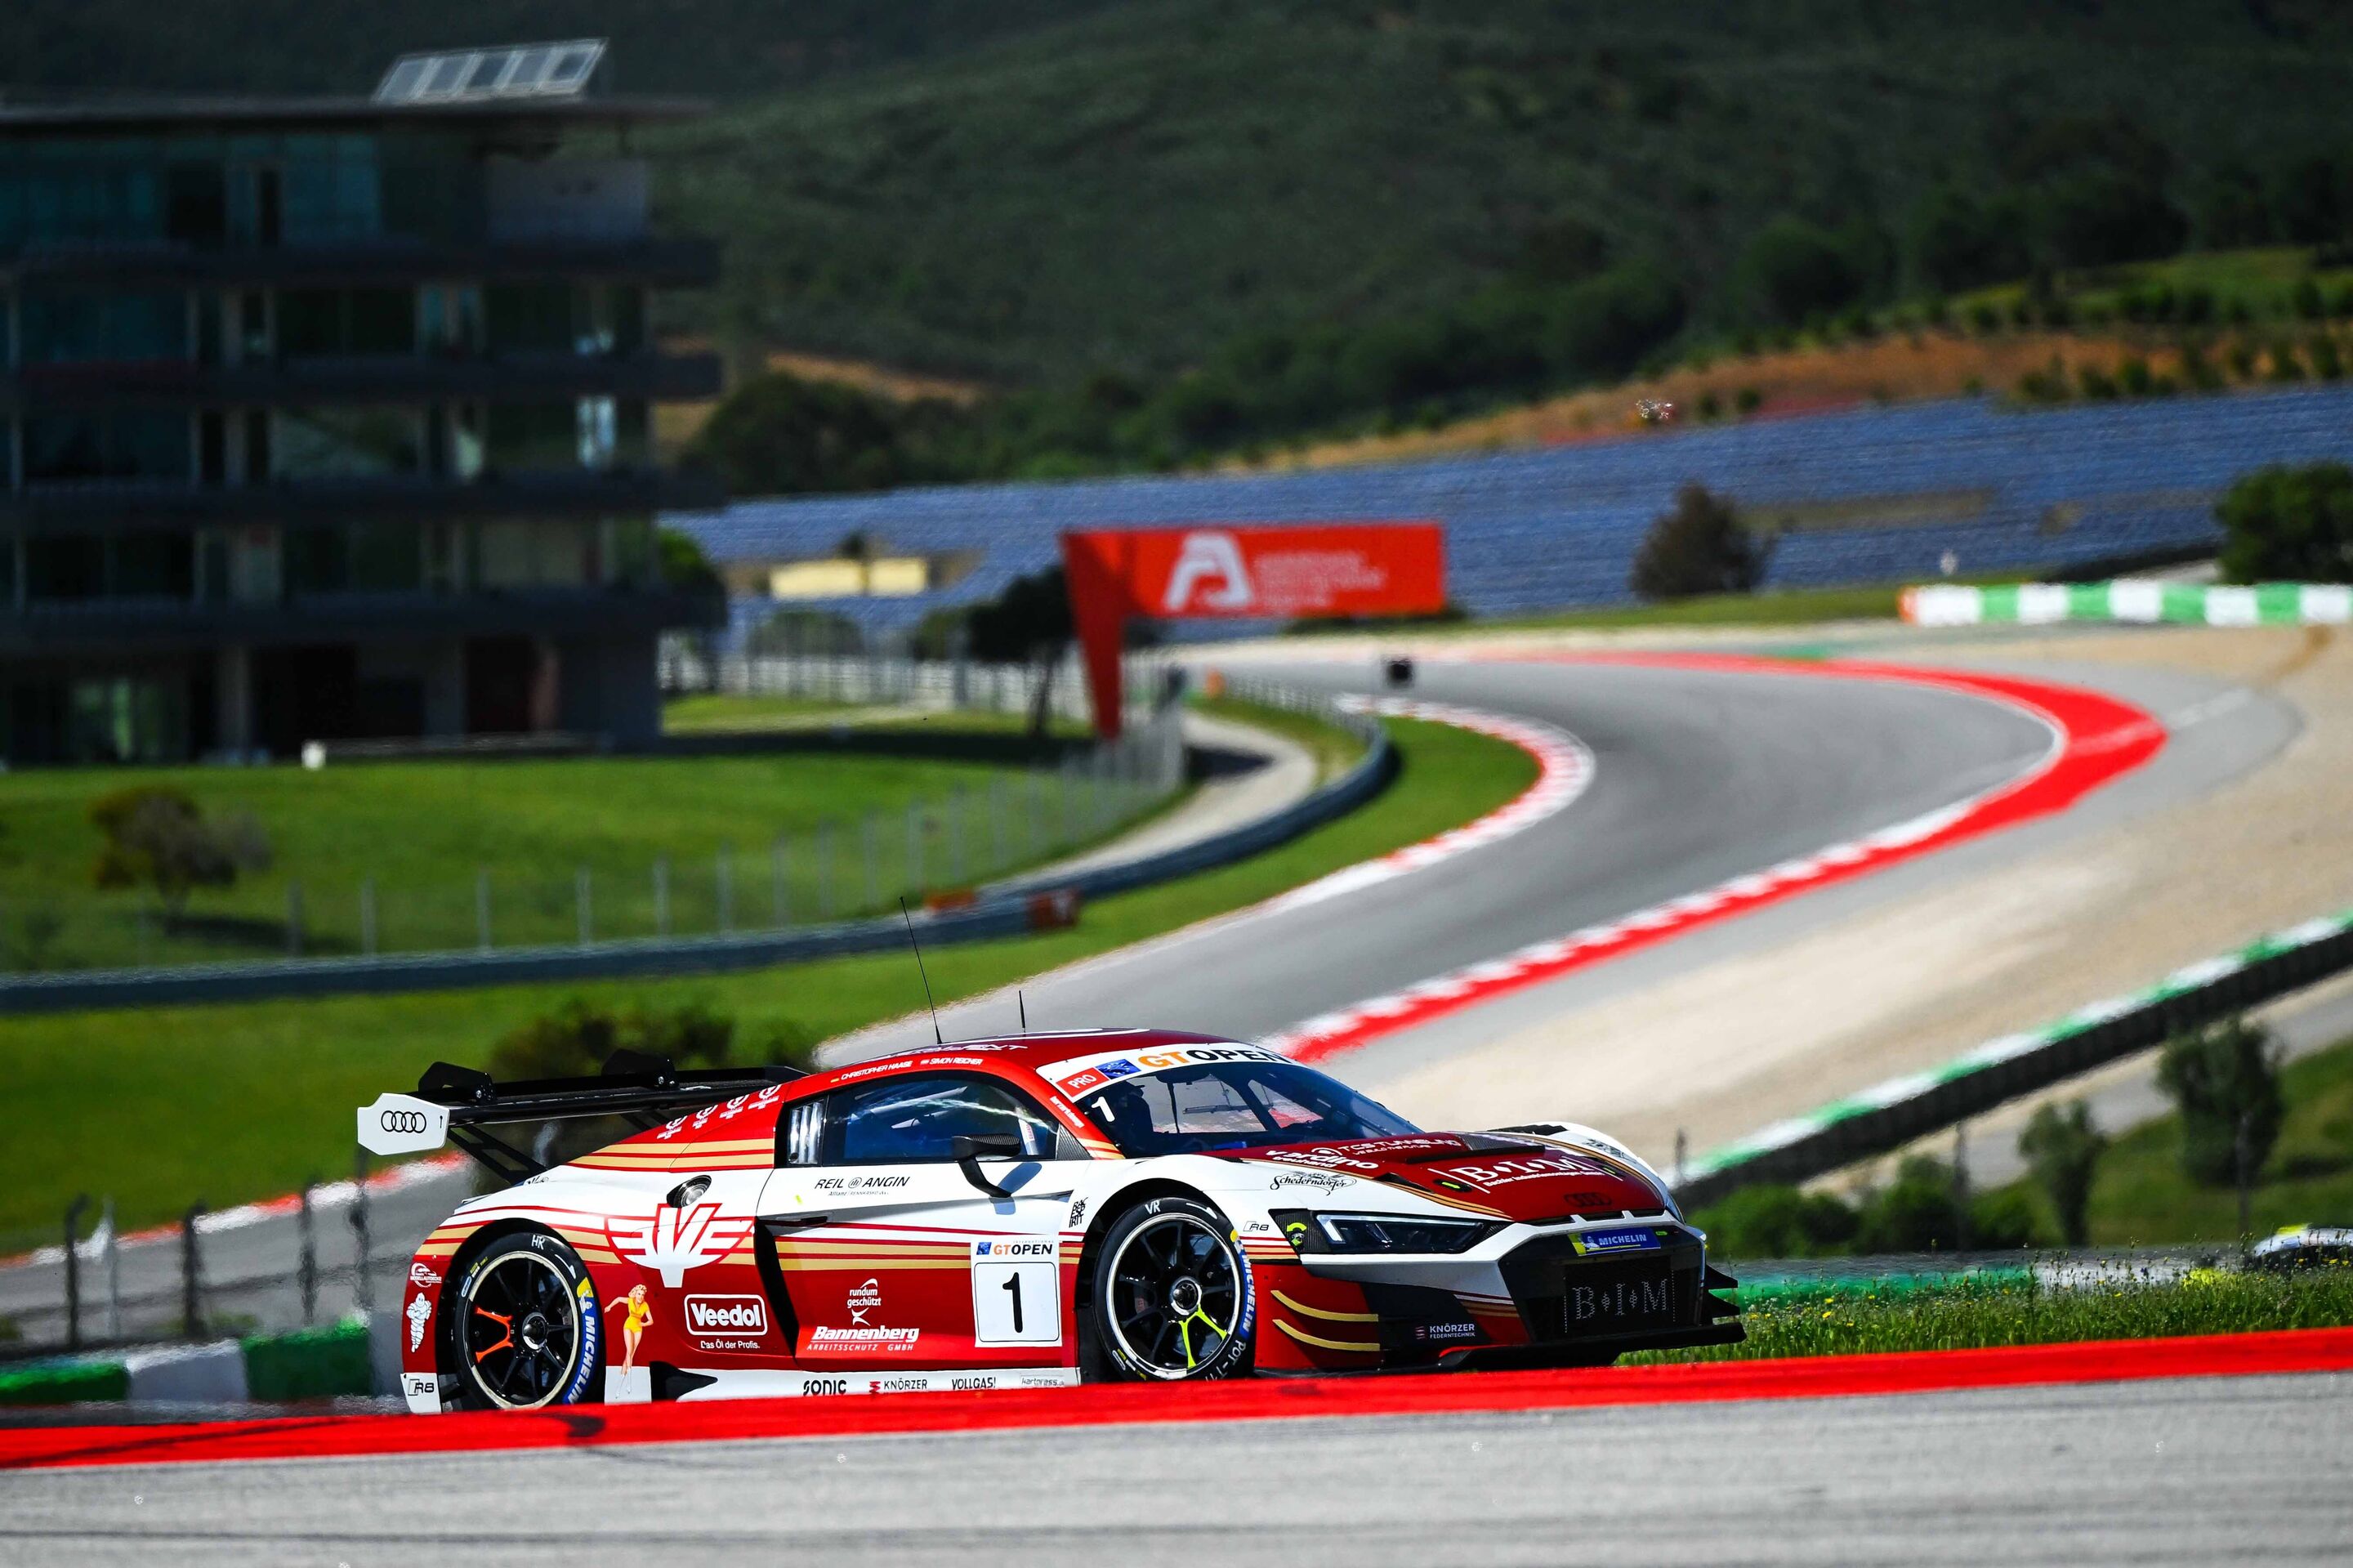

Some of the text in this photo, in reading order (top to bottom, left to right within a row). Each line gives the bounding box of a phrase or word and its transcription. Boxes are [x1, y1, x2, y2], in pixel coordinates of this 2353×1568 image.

[930, 1057, 953, 1065] SIMON
[841, 1061, 913, 1080] CHRISTOPHER HAASE
[1067, 1074, 1097, 1089] PRO
[1092, 1096, 1115, 1123] 1
[1338, 1142, 1375, 1151] TCS
[814, 1176, 911, 1190] REIL ANGIN
[1145, 1199, 1161, 1215] VR
[1249, 1222, 1270, 1231] R8
[1599, 1234, 1647, 1246] MICHELIN
[850, 1287, 878, 1296] rundum
[1241, 1253, 1256, 1333] MICHELIN
[846, 1297, 882, 1309] geschützt
[1002, 1271, 1023, 1333] 1
[690, 1303, 761, 1326] Veedol
[811, 1325, 920, 1342] Bannenberg
[1429, 1323, 1476, 1333] KNÖRZER
[700, 1338, 761, 1349] Das Öl der Profis.
[806, 1343, 914, 1351] ARBEITSSCHUTZ GMBH
[568, 1315, 595, 1405] MICHELIN
[413, 1382, 435, 1393] R8
[803, 1379, 847, 1396] SONIC
[883, 1378, 928, 1391] KNÖRZER
[952, 1377, 996, 1391] VOLLGAS!
